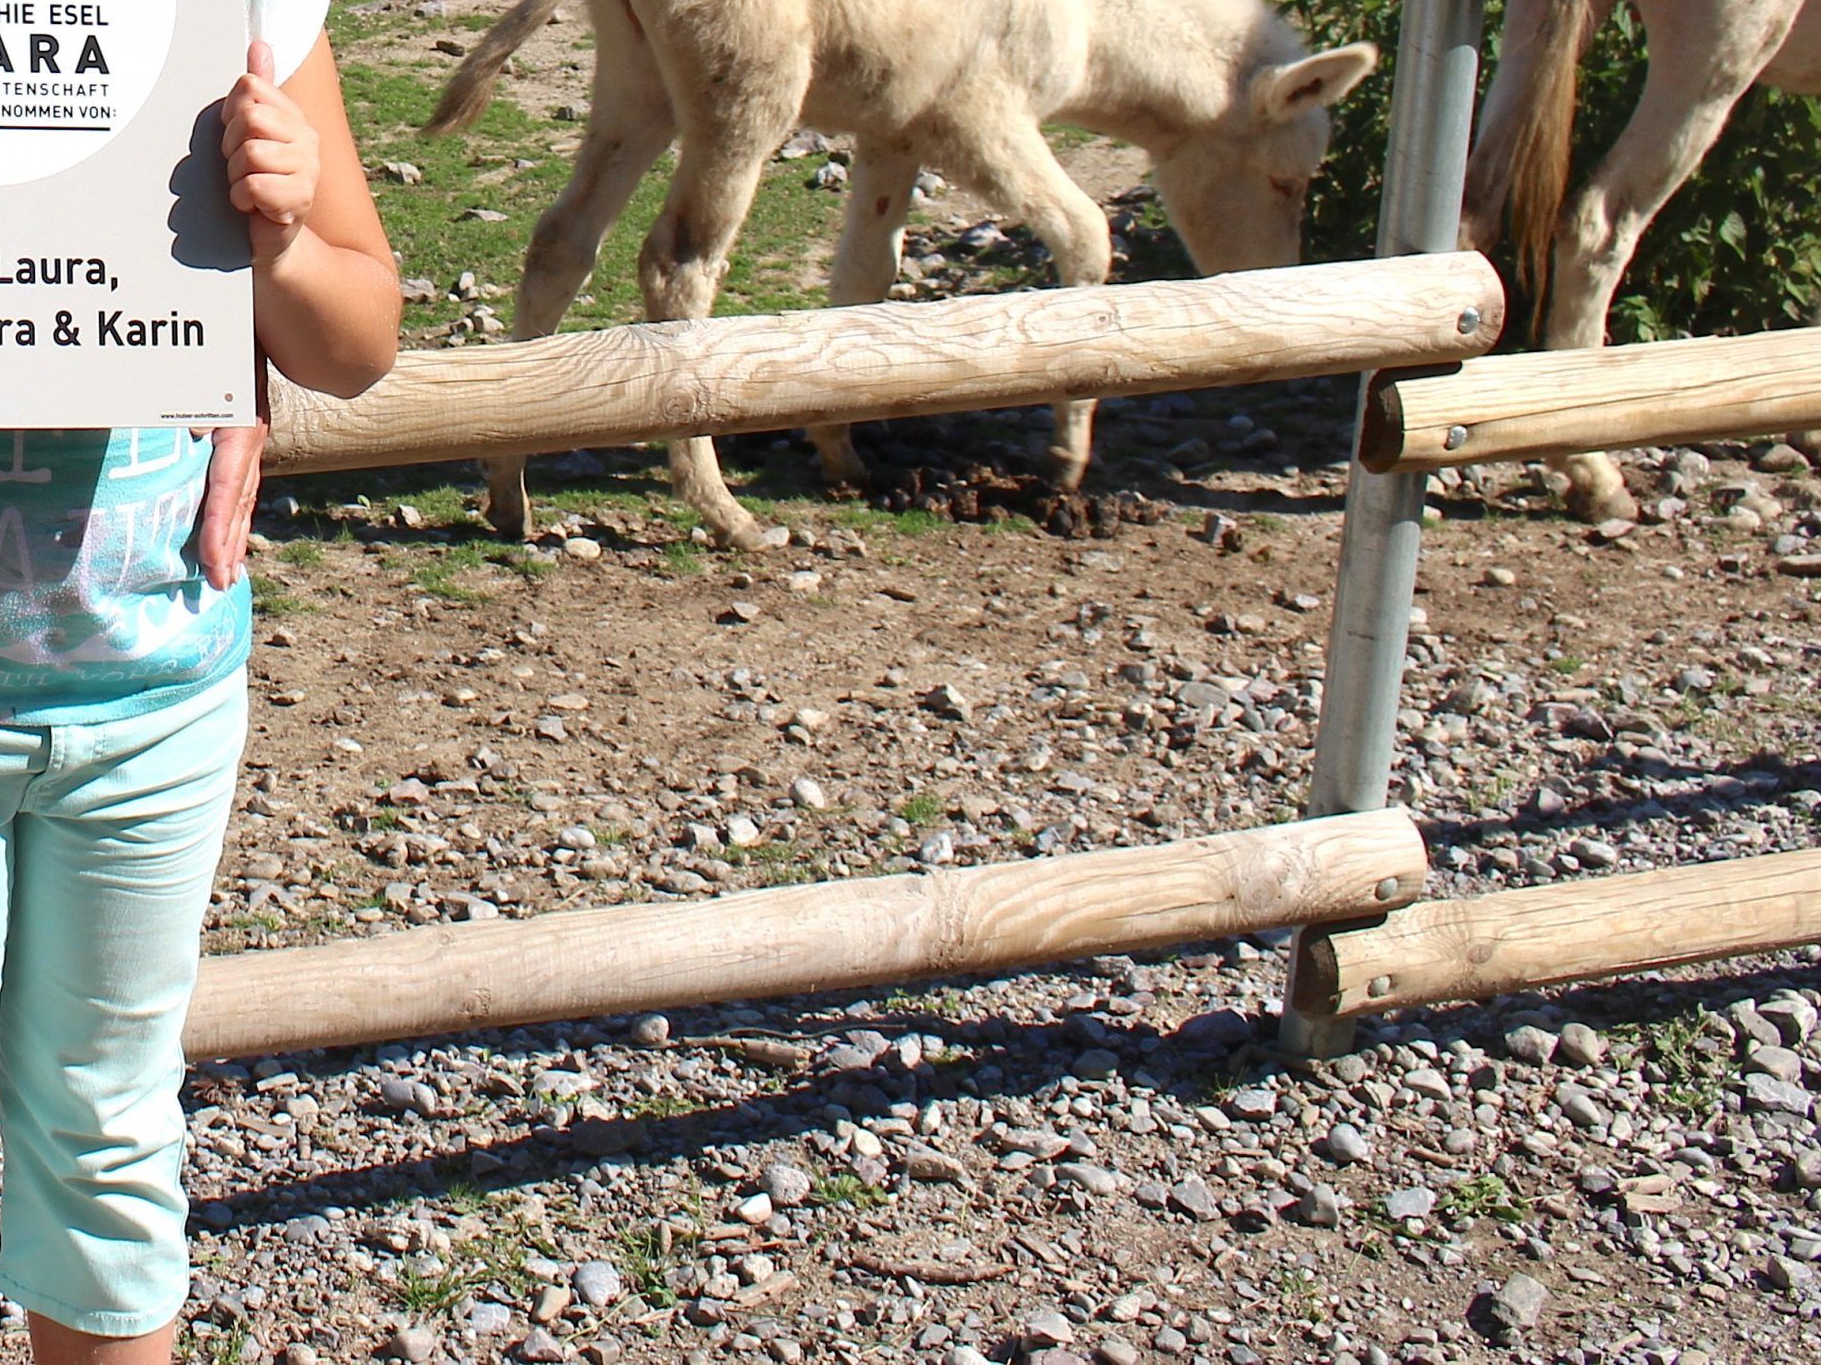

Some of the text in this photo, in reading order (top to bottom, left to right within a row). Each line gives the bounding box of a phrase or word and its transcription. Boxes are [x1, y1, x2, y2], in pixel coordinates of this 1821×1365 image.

[49, 4, 109, 26] ESEL
[78, 105, 118, 120] VON:
[52, 310, 80, 347] &
[98, 310, 206, 348] Karin
